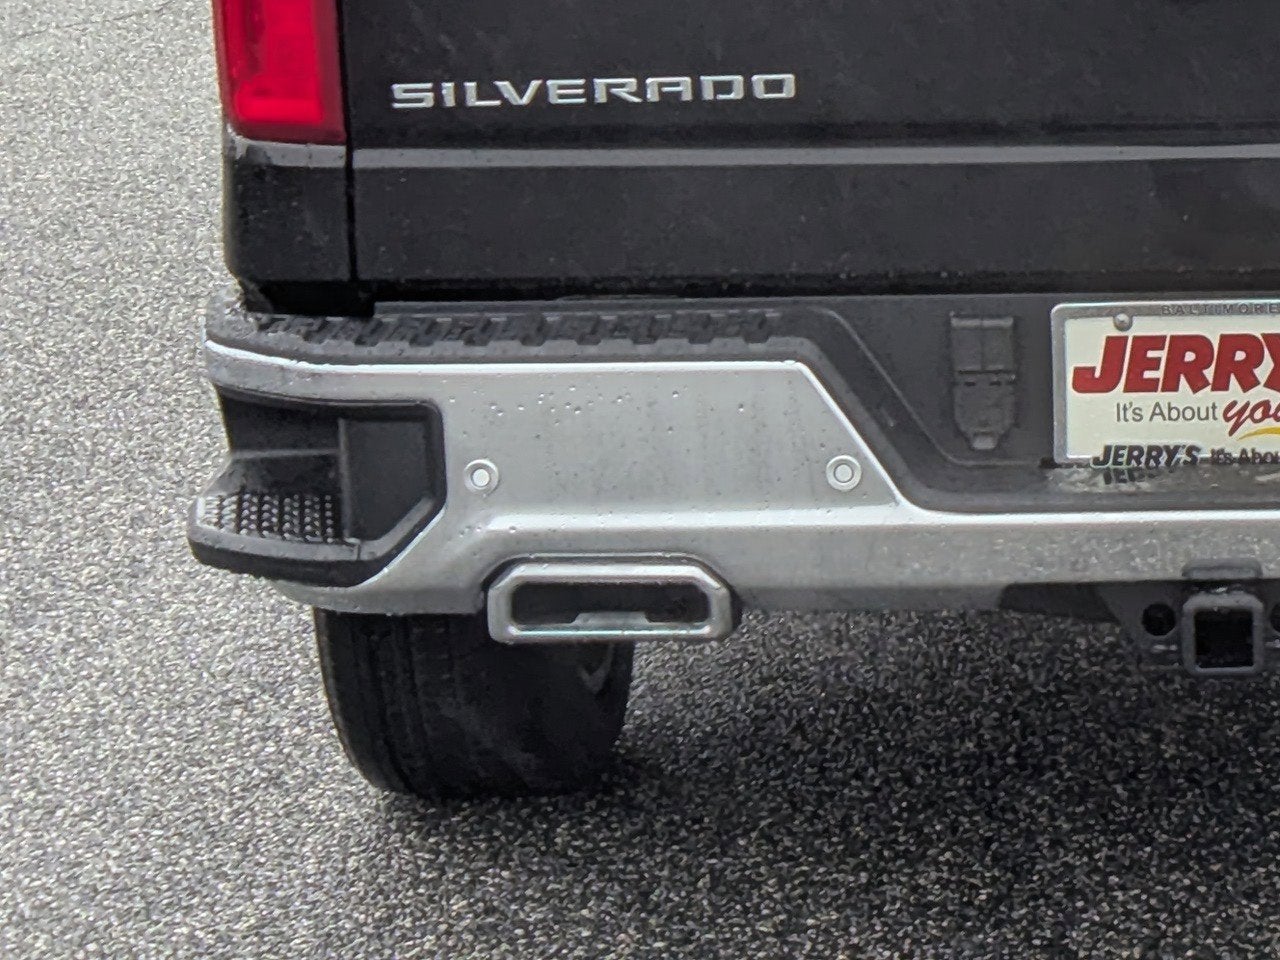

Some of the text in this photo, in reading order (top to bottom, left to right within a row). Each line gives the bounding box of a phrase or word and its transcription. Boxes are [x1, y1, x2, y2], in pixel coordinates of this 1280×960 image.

[390, 72, 797, 109] SILVERADO
[1161, 302, 1280, 316] BALTIMORE
[1116, 401, 1143, 423] It's
[1149, 401, 1218, 423] About
[1092, 444, 1201, 468] JERRY'S
